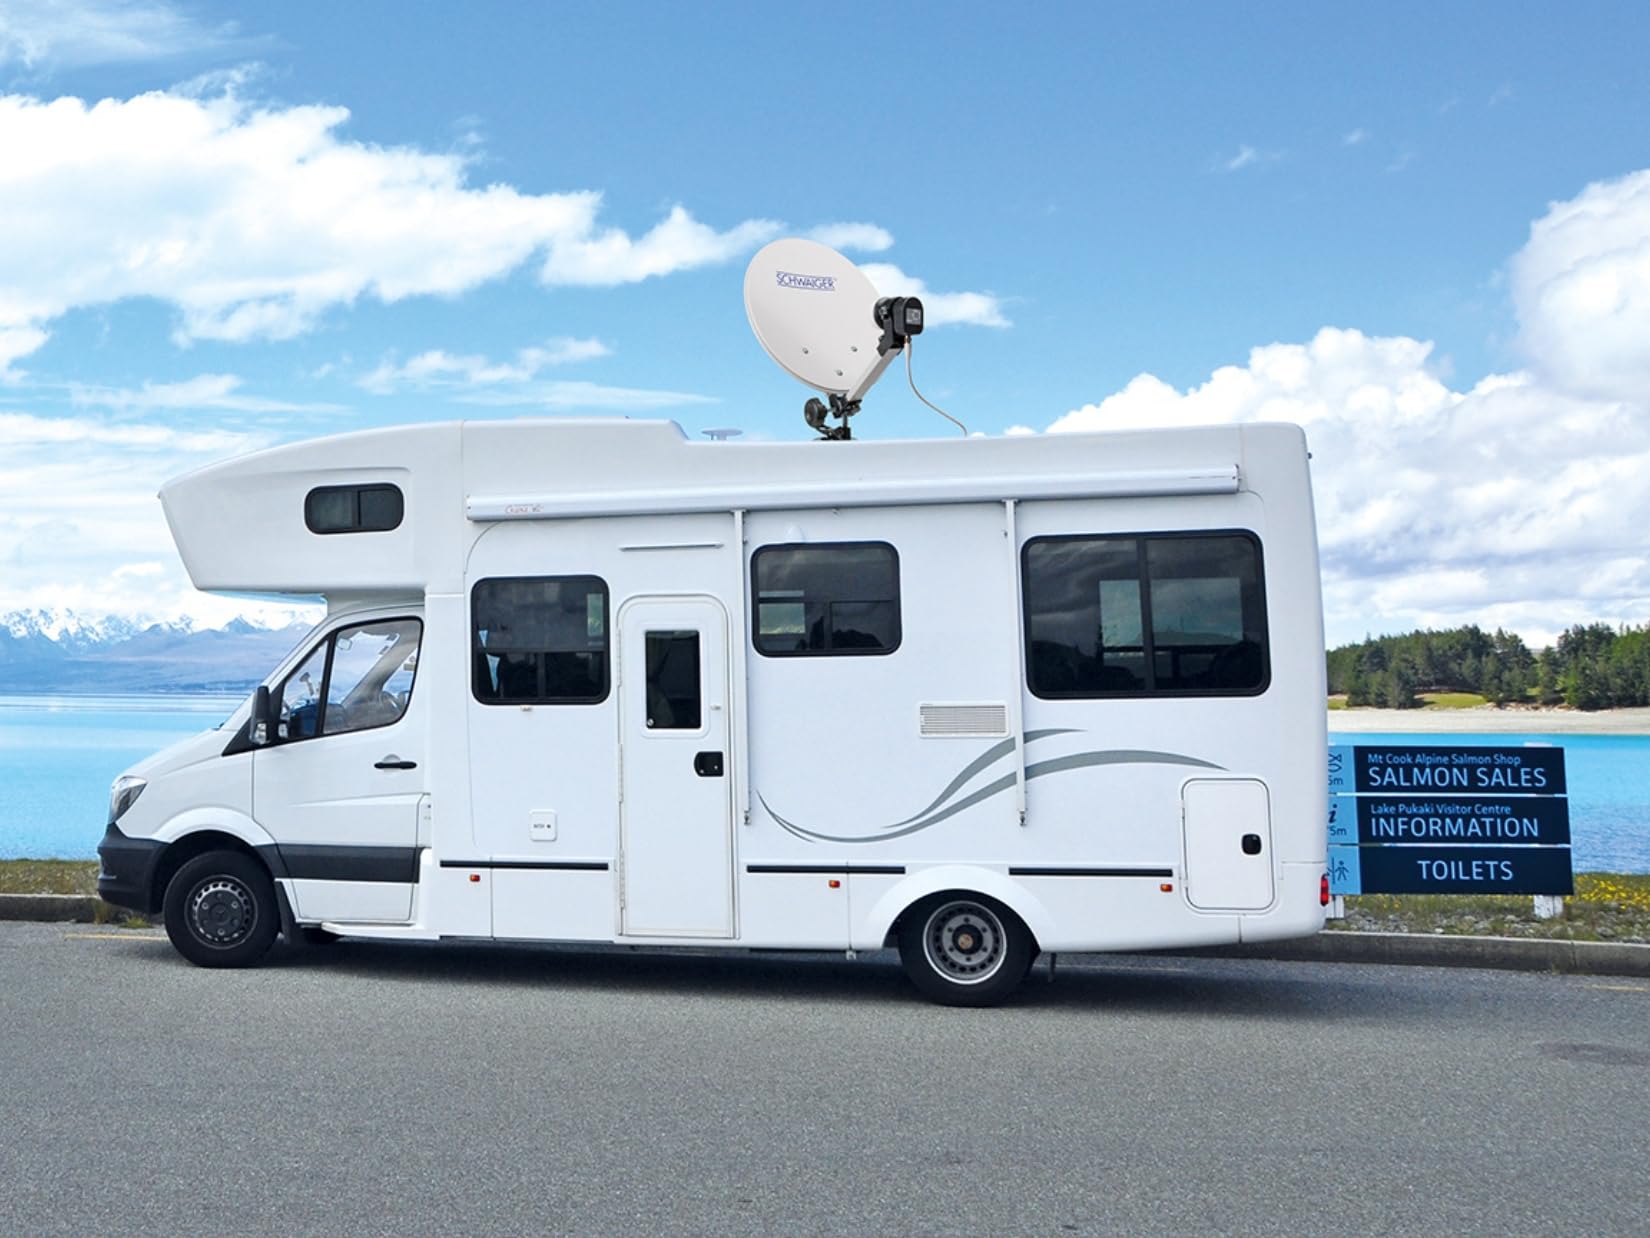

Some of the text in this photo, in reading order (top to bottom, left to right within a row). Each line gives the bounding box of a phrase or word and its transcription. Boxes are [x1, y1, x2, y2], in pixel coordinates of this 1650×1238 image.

[776, 271, 834, 291] SCHWAIGER
[1367, 753, 1521, 767] Mt Cook Alpine Salmon Shop
[1368, 766, 1547, 787] SALMON SALES
[1371, 803, 1511, 815] Lake Pukaki Visitor Centre
[1327, 825, 1347, 836] 5m
[1371, 817, 1539, 837] INFORMATION
[1417, 860, 1514, 881] TOILETS
